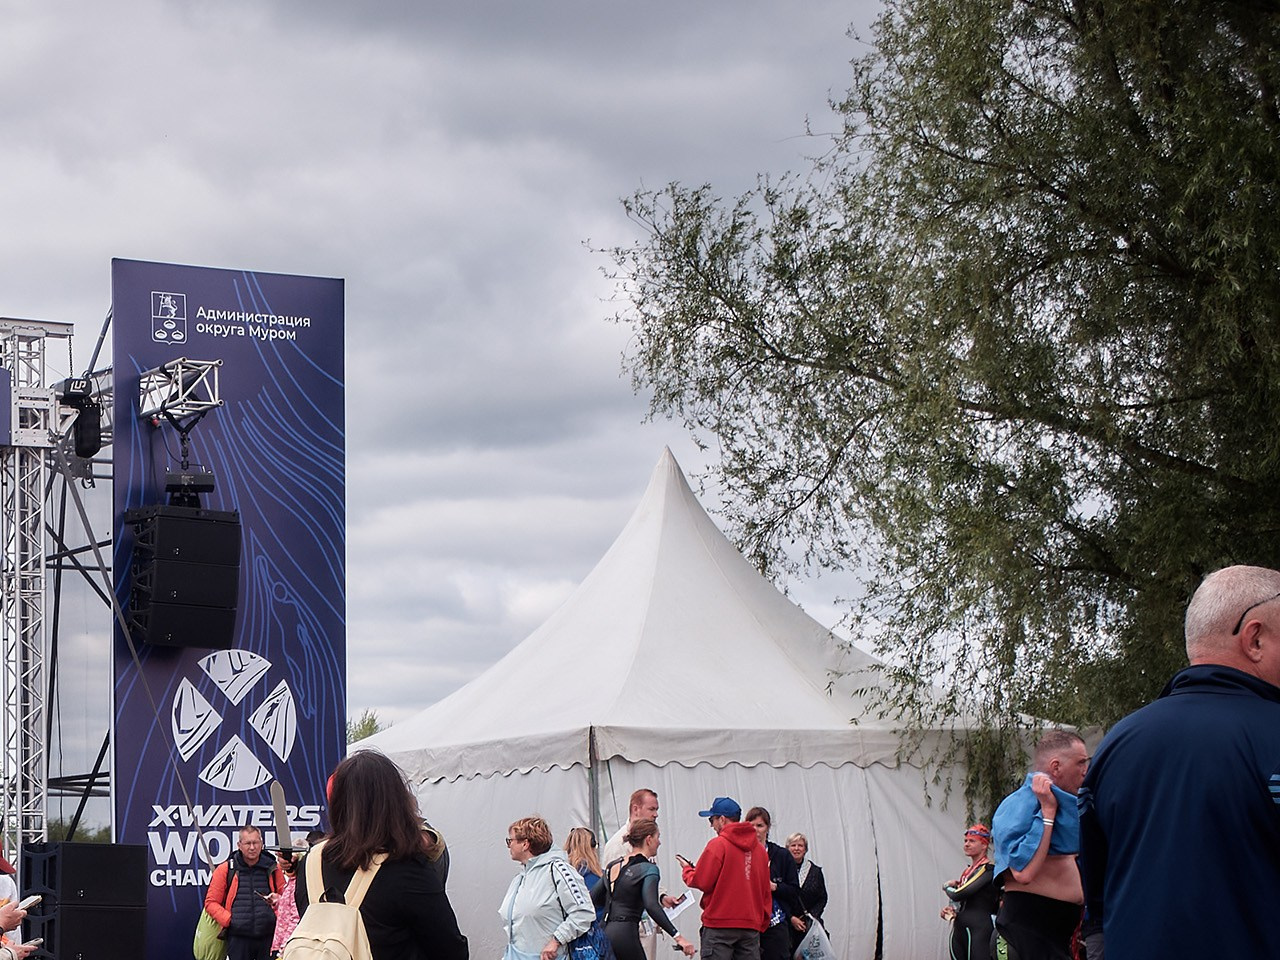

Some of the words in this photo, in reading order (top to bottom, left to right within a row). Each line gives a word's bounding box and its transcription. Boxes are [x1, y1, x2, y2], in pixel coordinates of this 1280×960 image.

[195, 306, 311, 328] Администрация
[196, 322, 245, 337] округа
[249, 325, 296, 341] Муром
